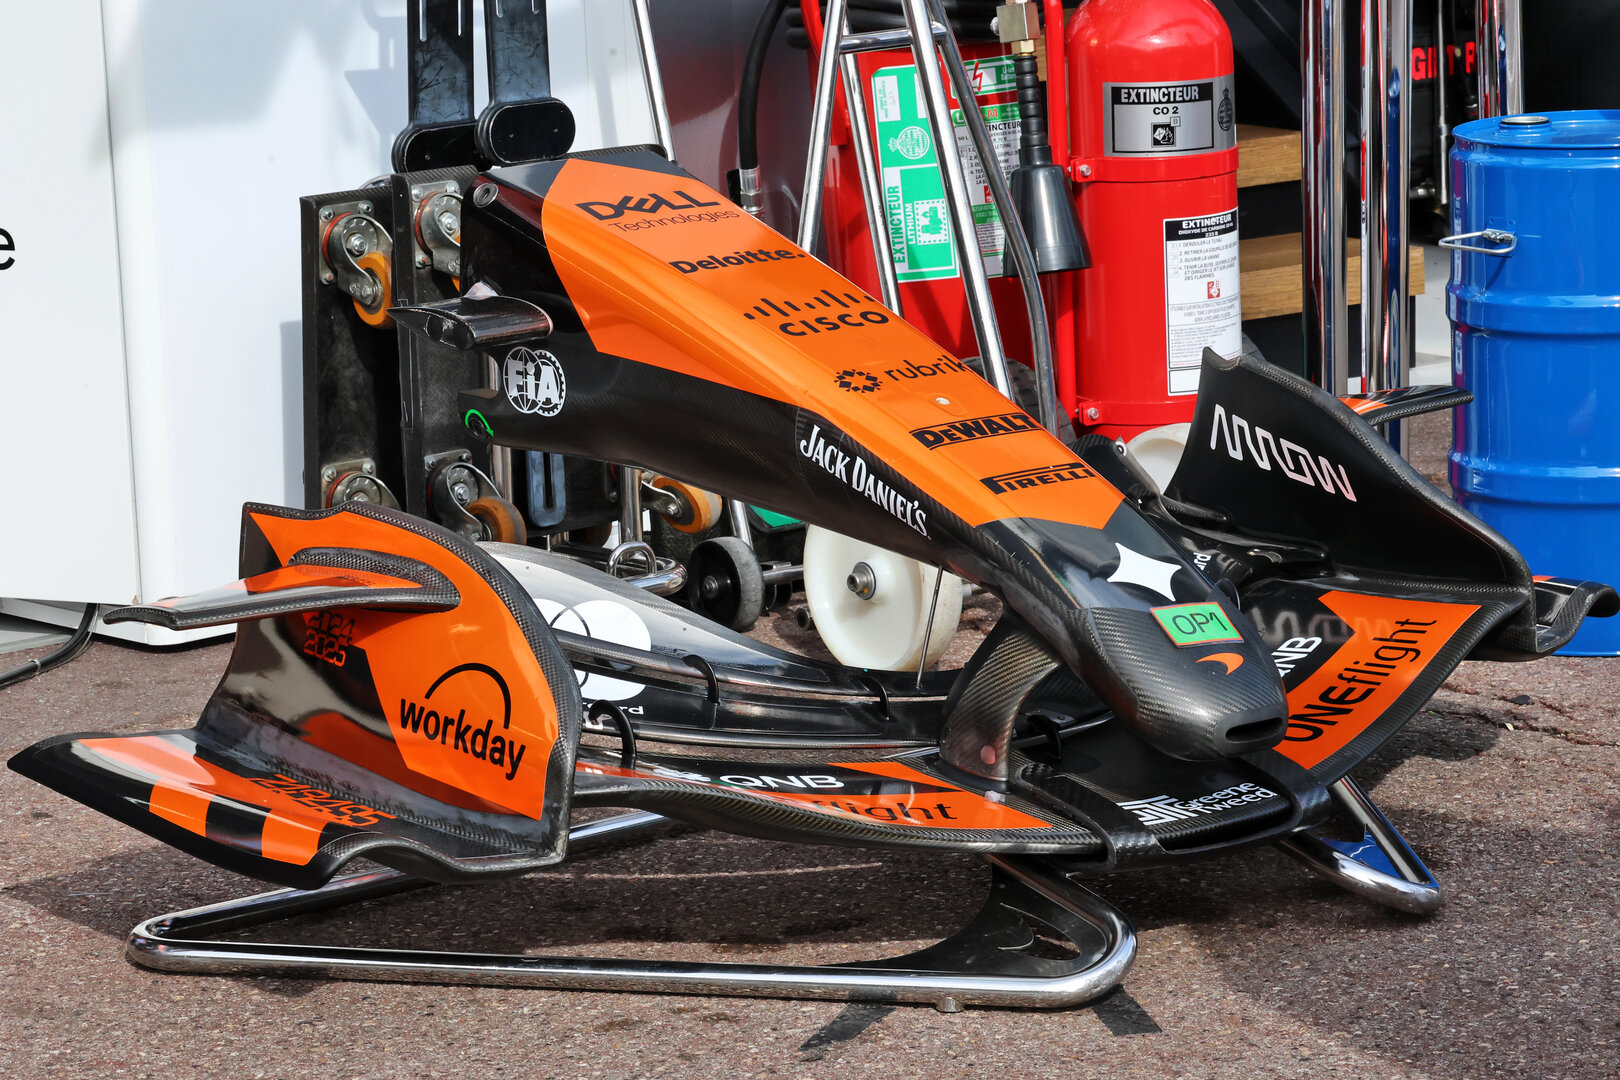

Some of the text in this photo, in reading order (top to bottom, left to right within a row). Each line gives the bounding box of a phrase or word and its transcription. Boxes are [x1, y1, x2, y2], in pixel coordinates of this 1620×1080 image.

[1121, 86, 1199, 103] EXTINCTEUR
[1153, 106, 1179, 115] CO 2
[575, 190, 721, 221] DELL
[608, 209, 740, 232] Technologies
[887, 185, 906, 264] EXTINCTEUR
[905, 203, 916, 245] LITHIUM
[1182, 214, 1232, 229] EXTINCTEUR
[668, 249, 806, 274] Deloitte.
[884, 355, 967, 381] rubrik
[800, 424, 851, 484] JACK
[980, 462, 1097, 495] PIRELLI
[1172, 611, 1228, 635] OP1
[400, 698, 526, 781] workday
[719, 775, 845, 789] QNB
[1173, 782, 1256, 810] Greene
